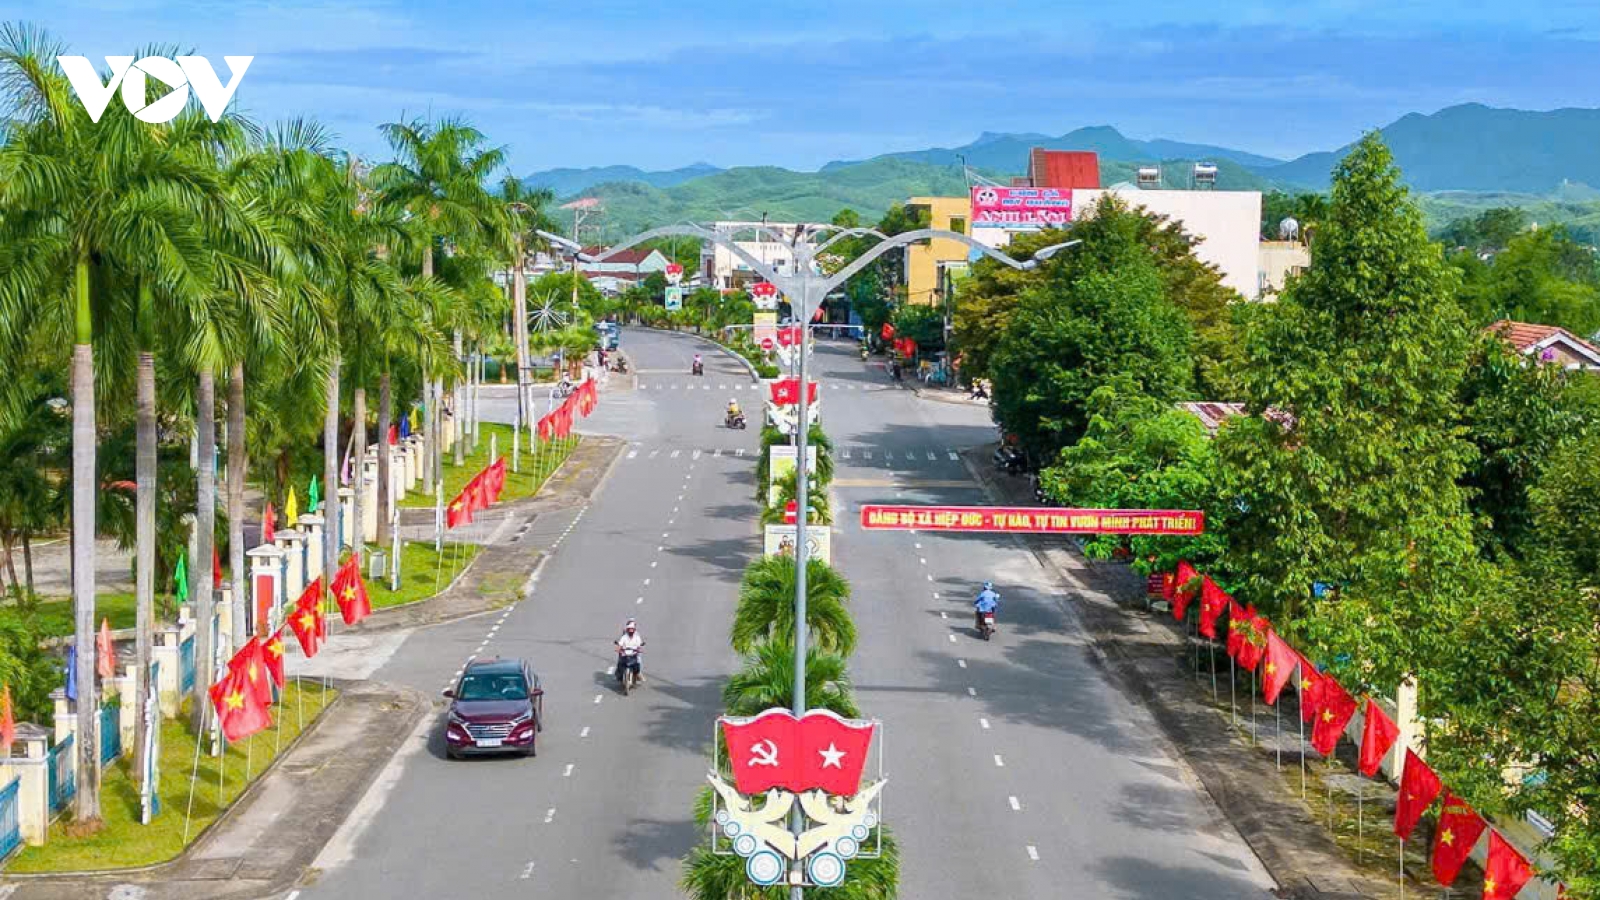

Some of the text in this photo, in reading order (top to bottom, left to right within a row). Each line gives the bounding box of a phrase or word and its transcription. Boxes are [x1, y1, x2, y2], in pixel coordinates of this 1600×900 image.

[980, 210, 1020, 222] ANH
[934, 511, 959, 527] HIỆP
[993, 512, 1007, 529] TỰ
[1035, 514, 1049, 531] TỰ
[1051, 515, 1067, 528] TIN
[1101, 515, 1129, 529] MÌNH
[1132, 515, 1158, 530] PHÁT
[1161, 513, 1196, 530] TRIỂN!
